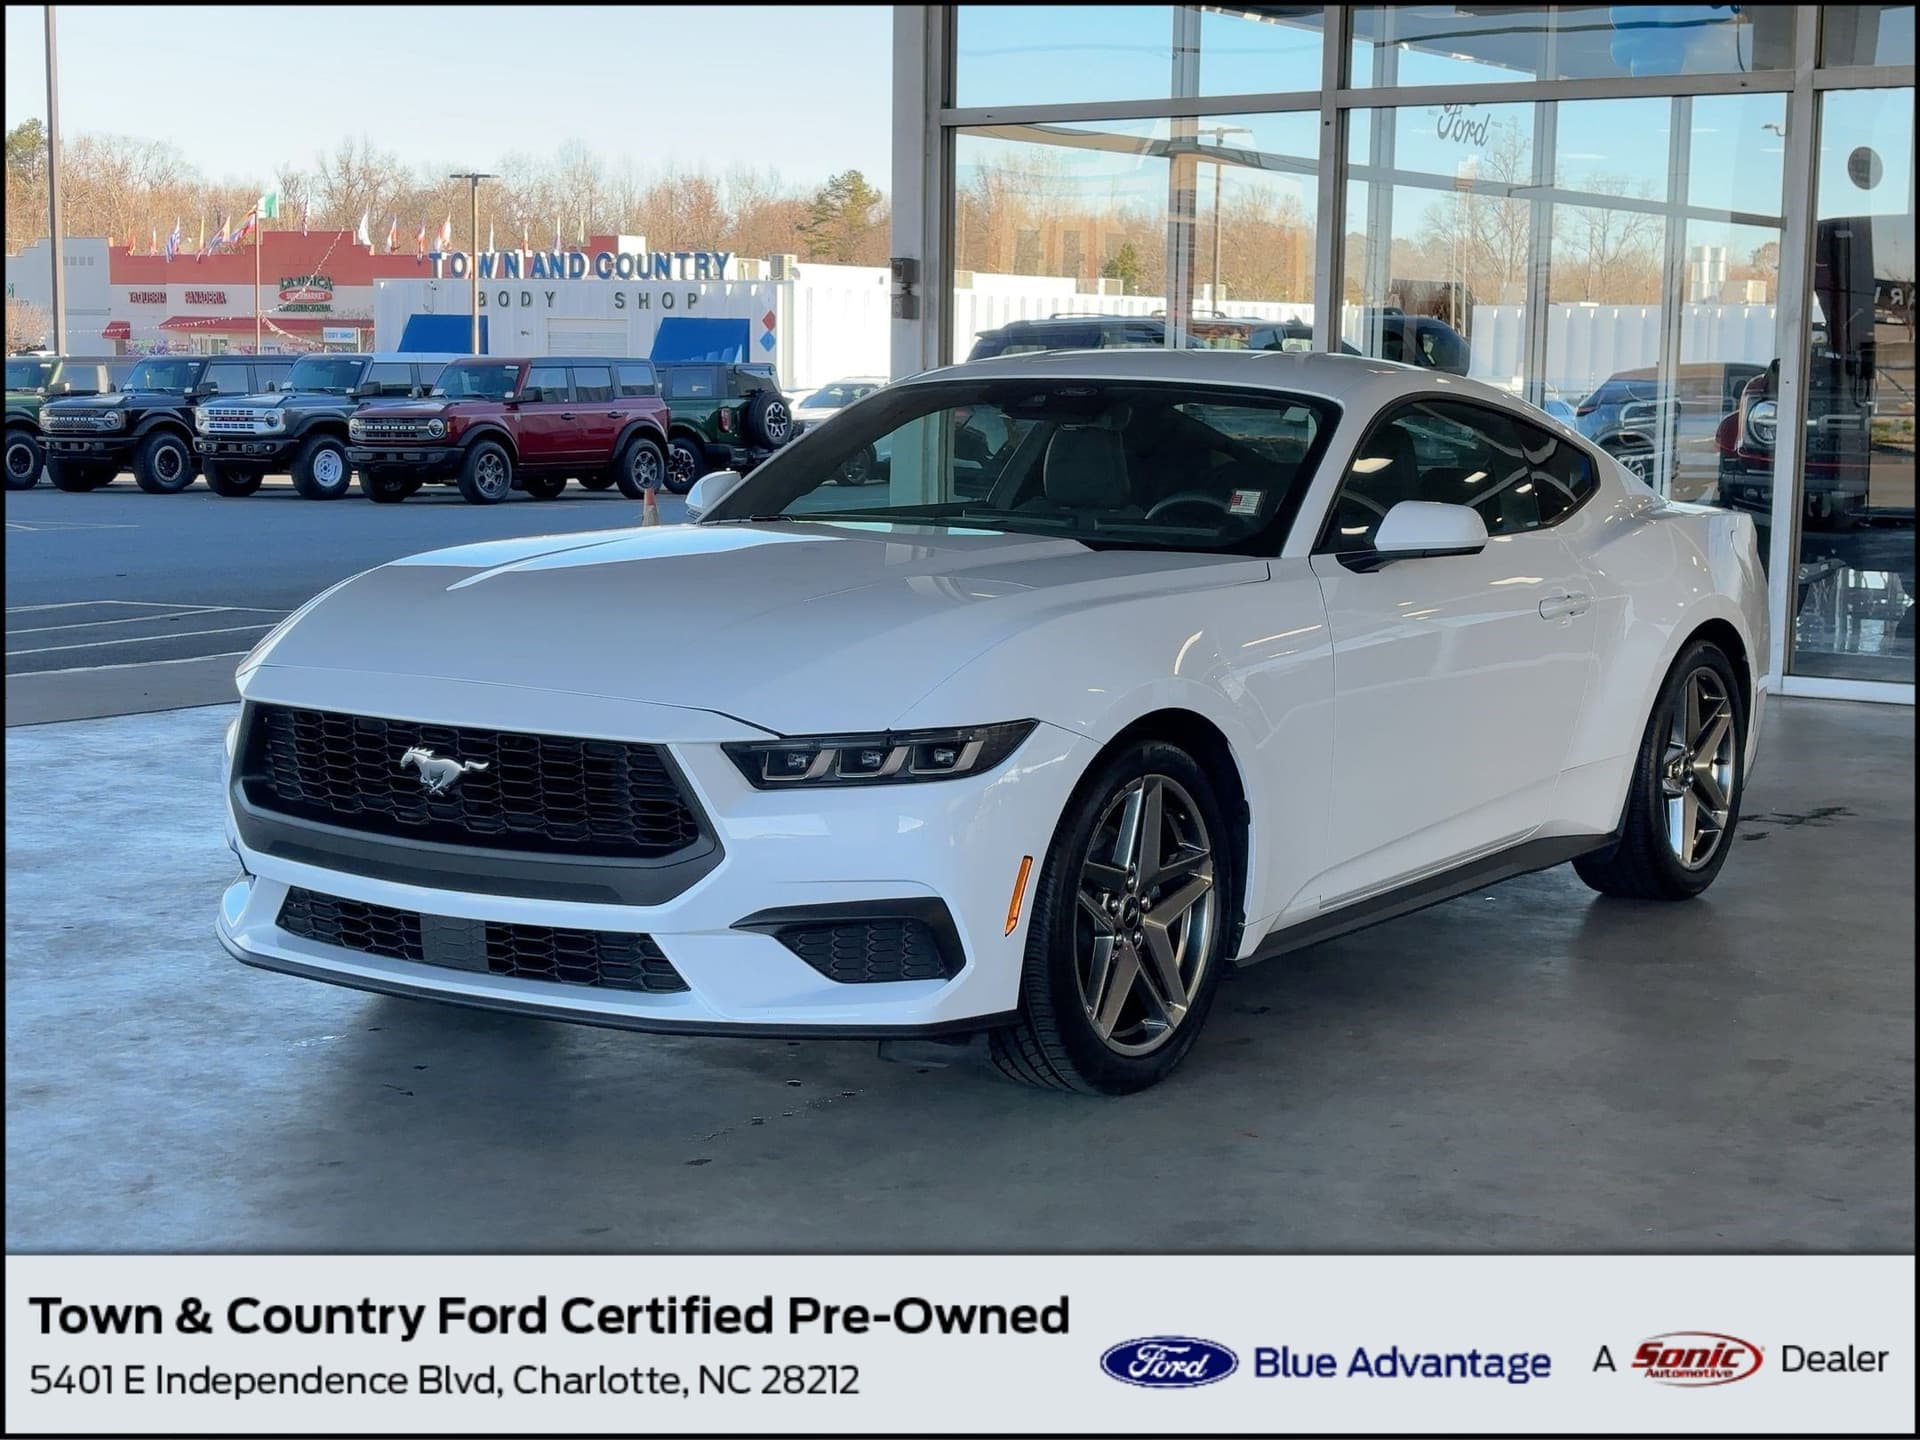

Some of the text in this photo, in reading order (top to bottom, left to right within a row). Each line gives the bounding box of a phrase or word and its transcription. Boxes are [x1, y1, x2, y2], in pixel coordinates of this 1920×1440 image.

[1434, 103, 1491, 147] Ford
[429, 251, 732, 280] TOWN AND COUNTRY
[479, 291, 699, 309] BODY SHOP
